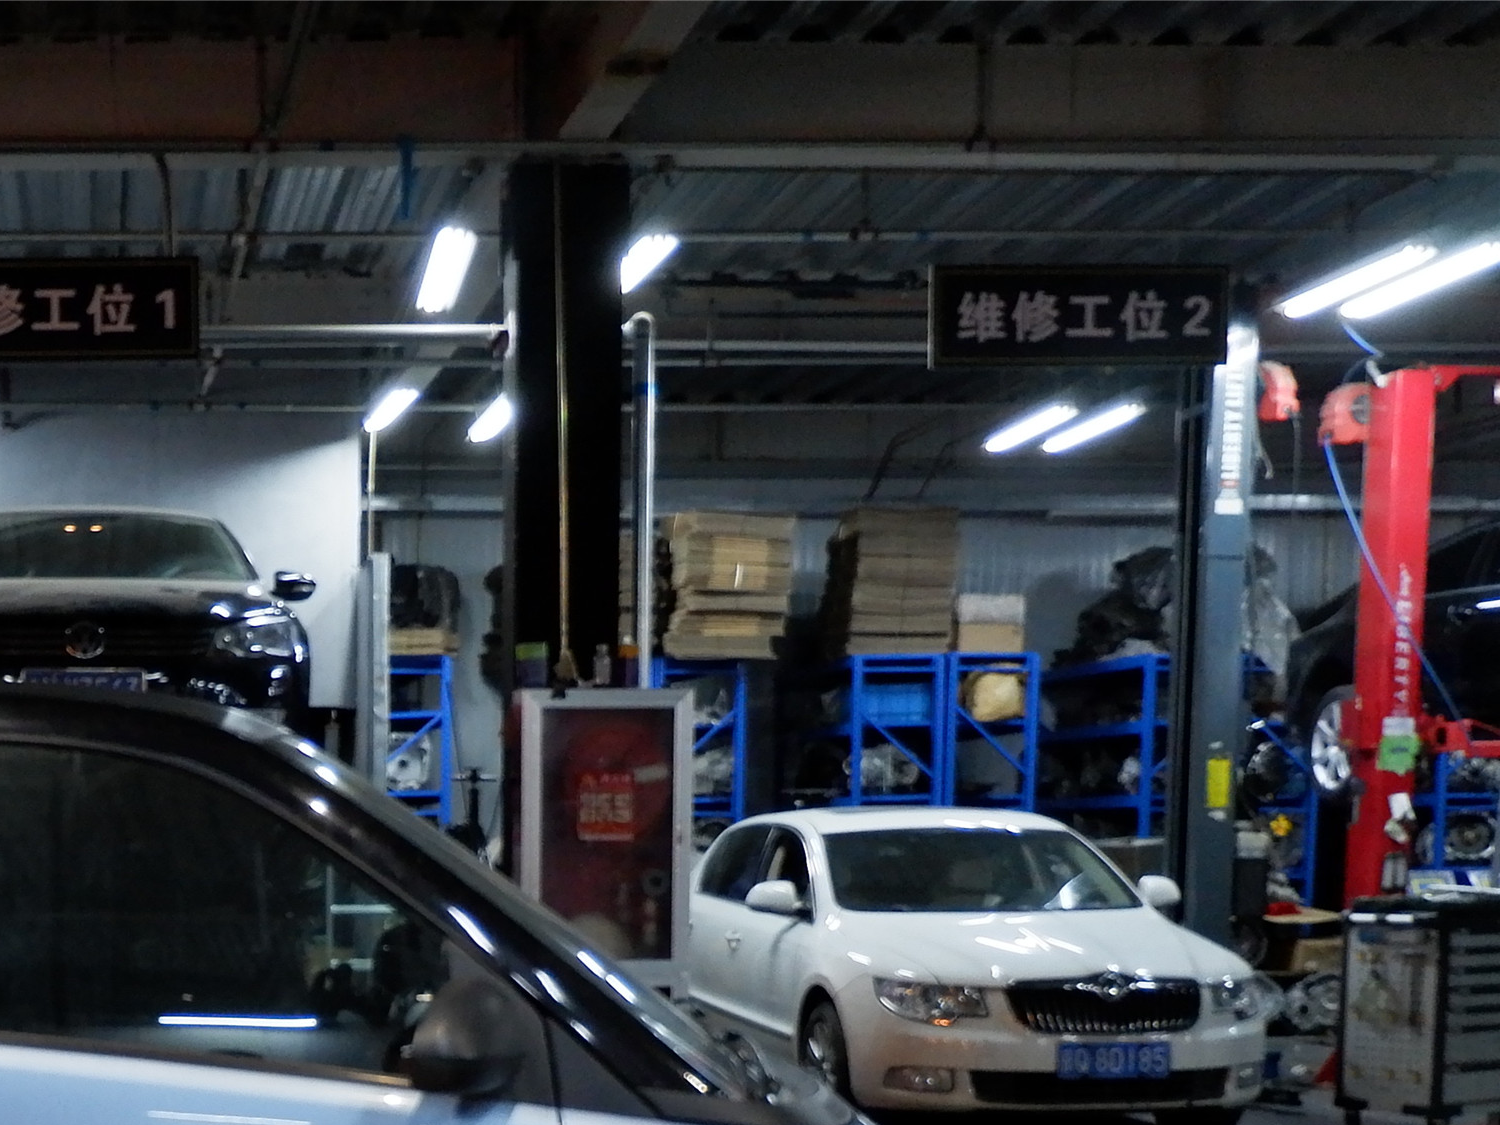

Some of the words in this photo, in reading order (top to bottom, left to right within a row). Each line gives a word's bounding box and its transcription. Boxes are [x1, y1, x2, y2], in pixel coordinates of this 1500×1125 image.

[155, 288, 177, 329] 1
[956, 289, 1170, 343] 维修工位
[1182, 294, 1213, 337] 2
